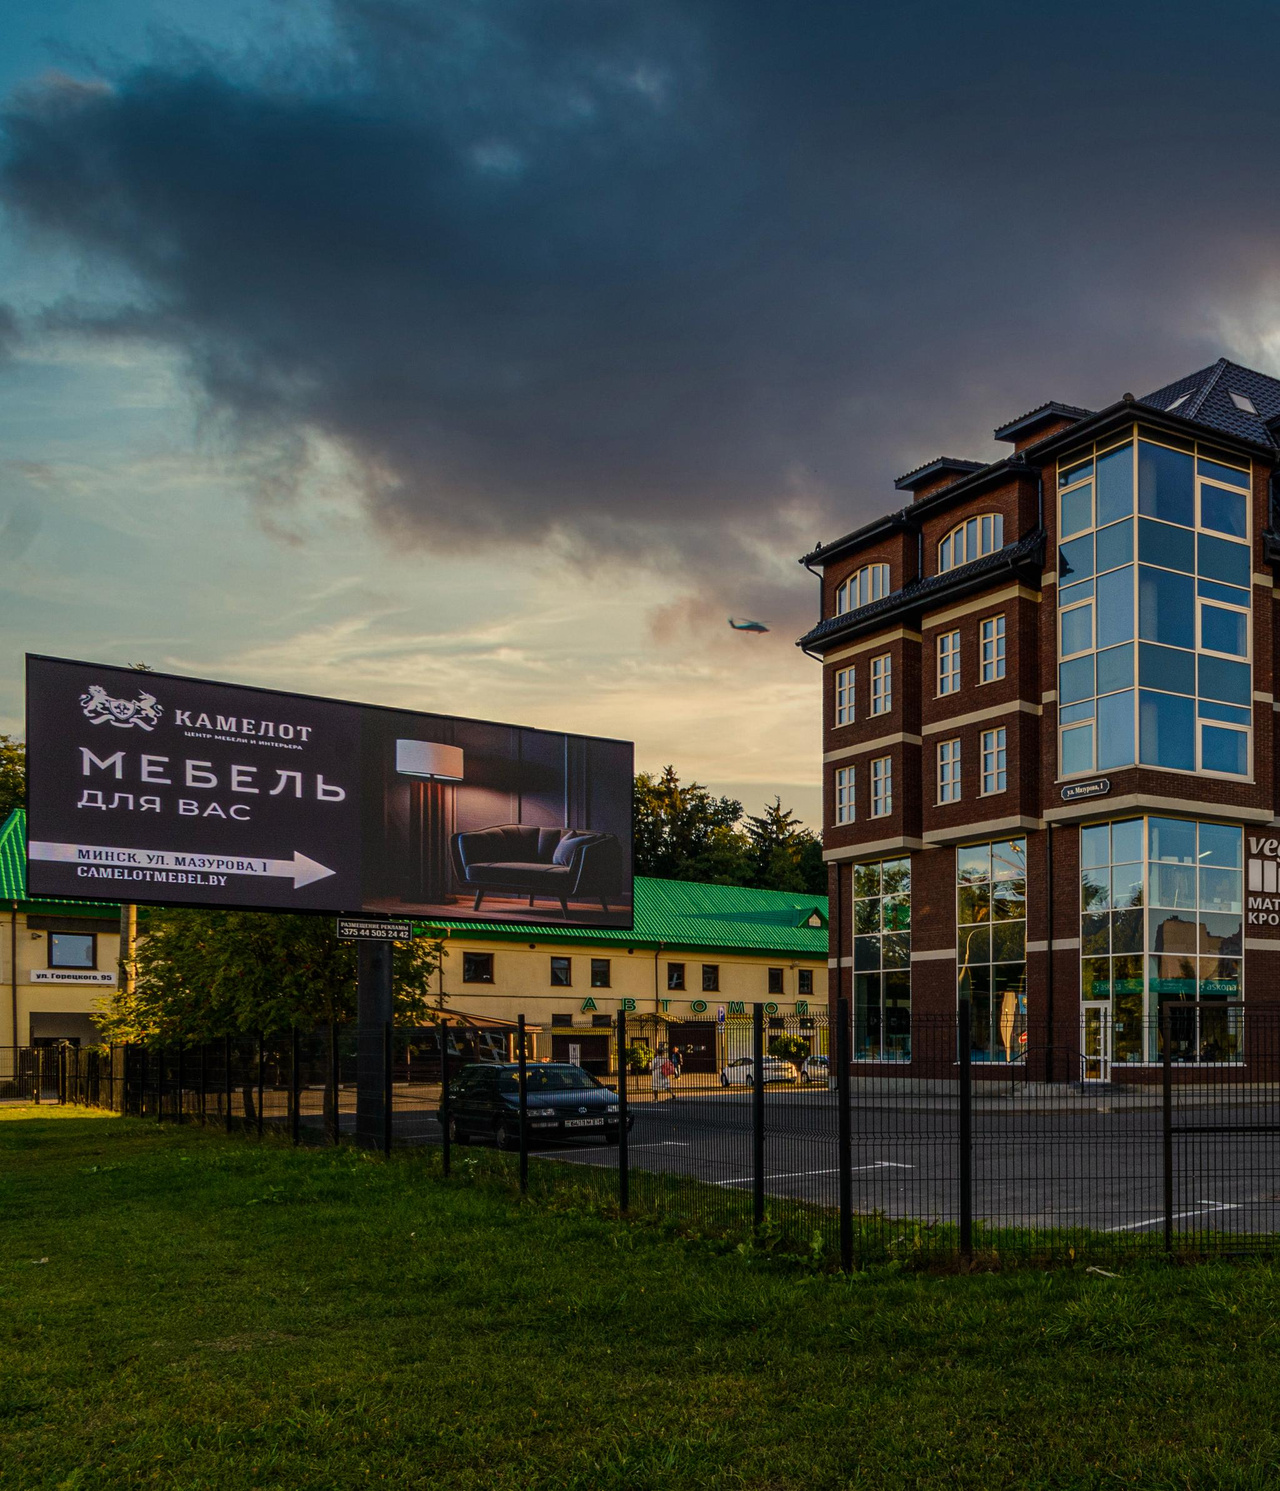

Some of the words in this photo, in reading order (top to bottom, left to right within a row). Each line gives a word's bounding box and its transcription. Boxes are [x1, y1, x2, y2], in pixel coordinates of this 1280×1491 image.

[175, 709, 312, 742] КАМЕЛОТ
[184, 731, 212, 739] ЦЕНТР
[214, 734, 248, 744] МЕБЕЛИ
[258, 741, 304, 751] ИНТЕРЬЕРА
[78, 747, 346, 802] МЕБЕЛЬ
[77, 789, 161, 813] ДЛЯ
[178, 799, 251, 821] ВАС
[77, 849, 142, 865] МИНСК,
[146, 854, 170, 866] УЛ.
[174, 856, 258, 873] МАЗУРОВА,
[262, 862, 268, 873] 1
[77, 866, 228, 887] CAMELOTMEBEL.BY
[1206, 983, 1237, 991] askona
